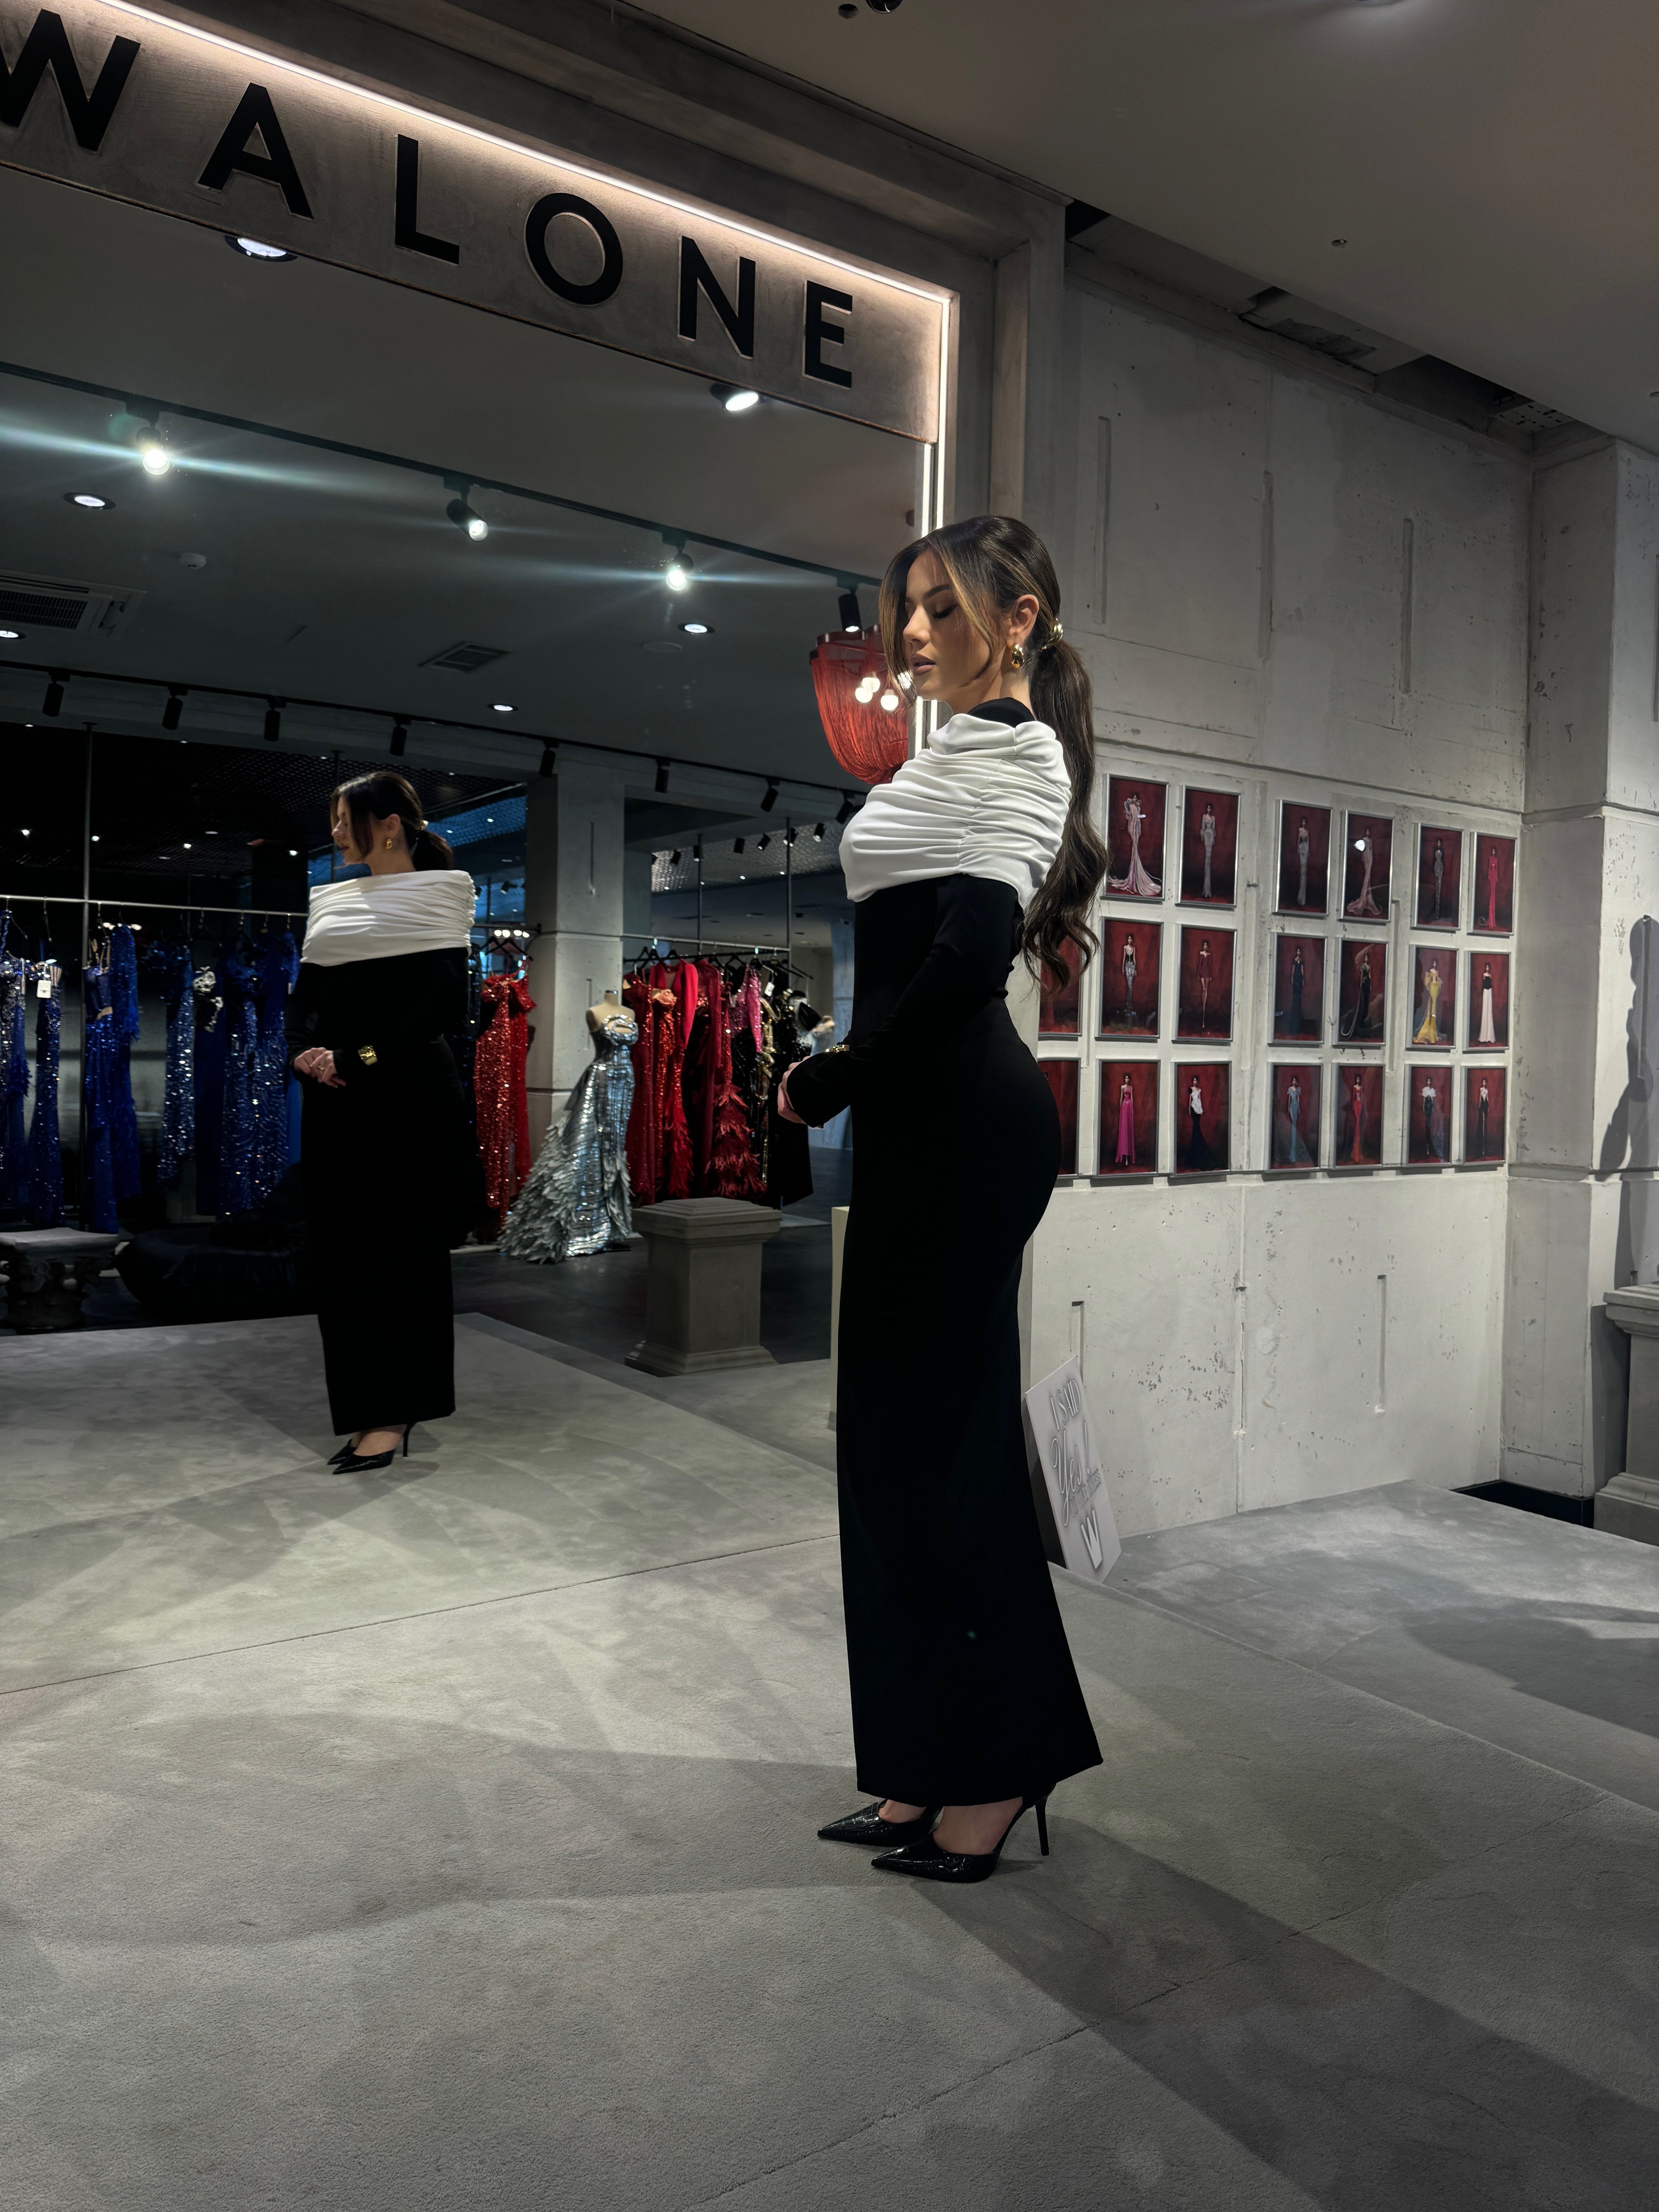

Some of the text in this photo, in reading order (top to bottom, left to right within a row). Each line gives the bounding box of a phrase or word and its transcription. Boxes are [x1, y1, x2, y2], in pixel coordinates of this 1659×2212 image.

[0, 9, 854, 388] WALONE
[1050, 1380, 1081, 1430] I SAID
